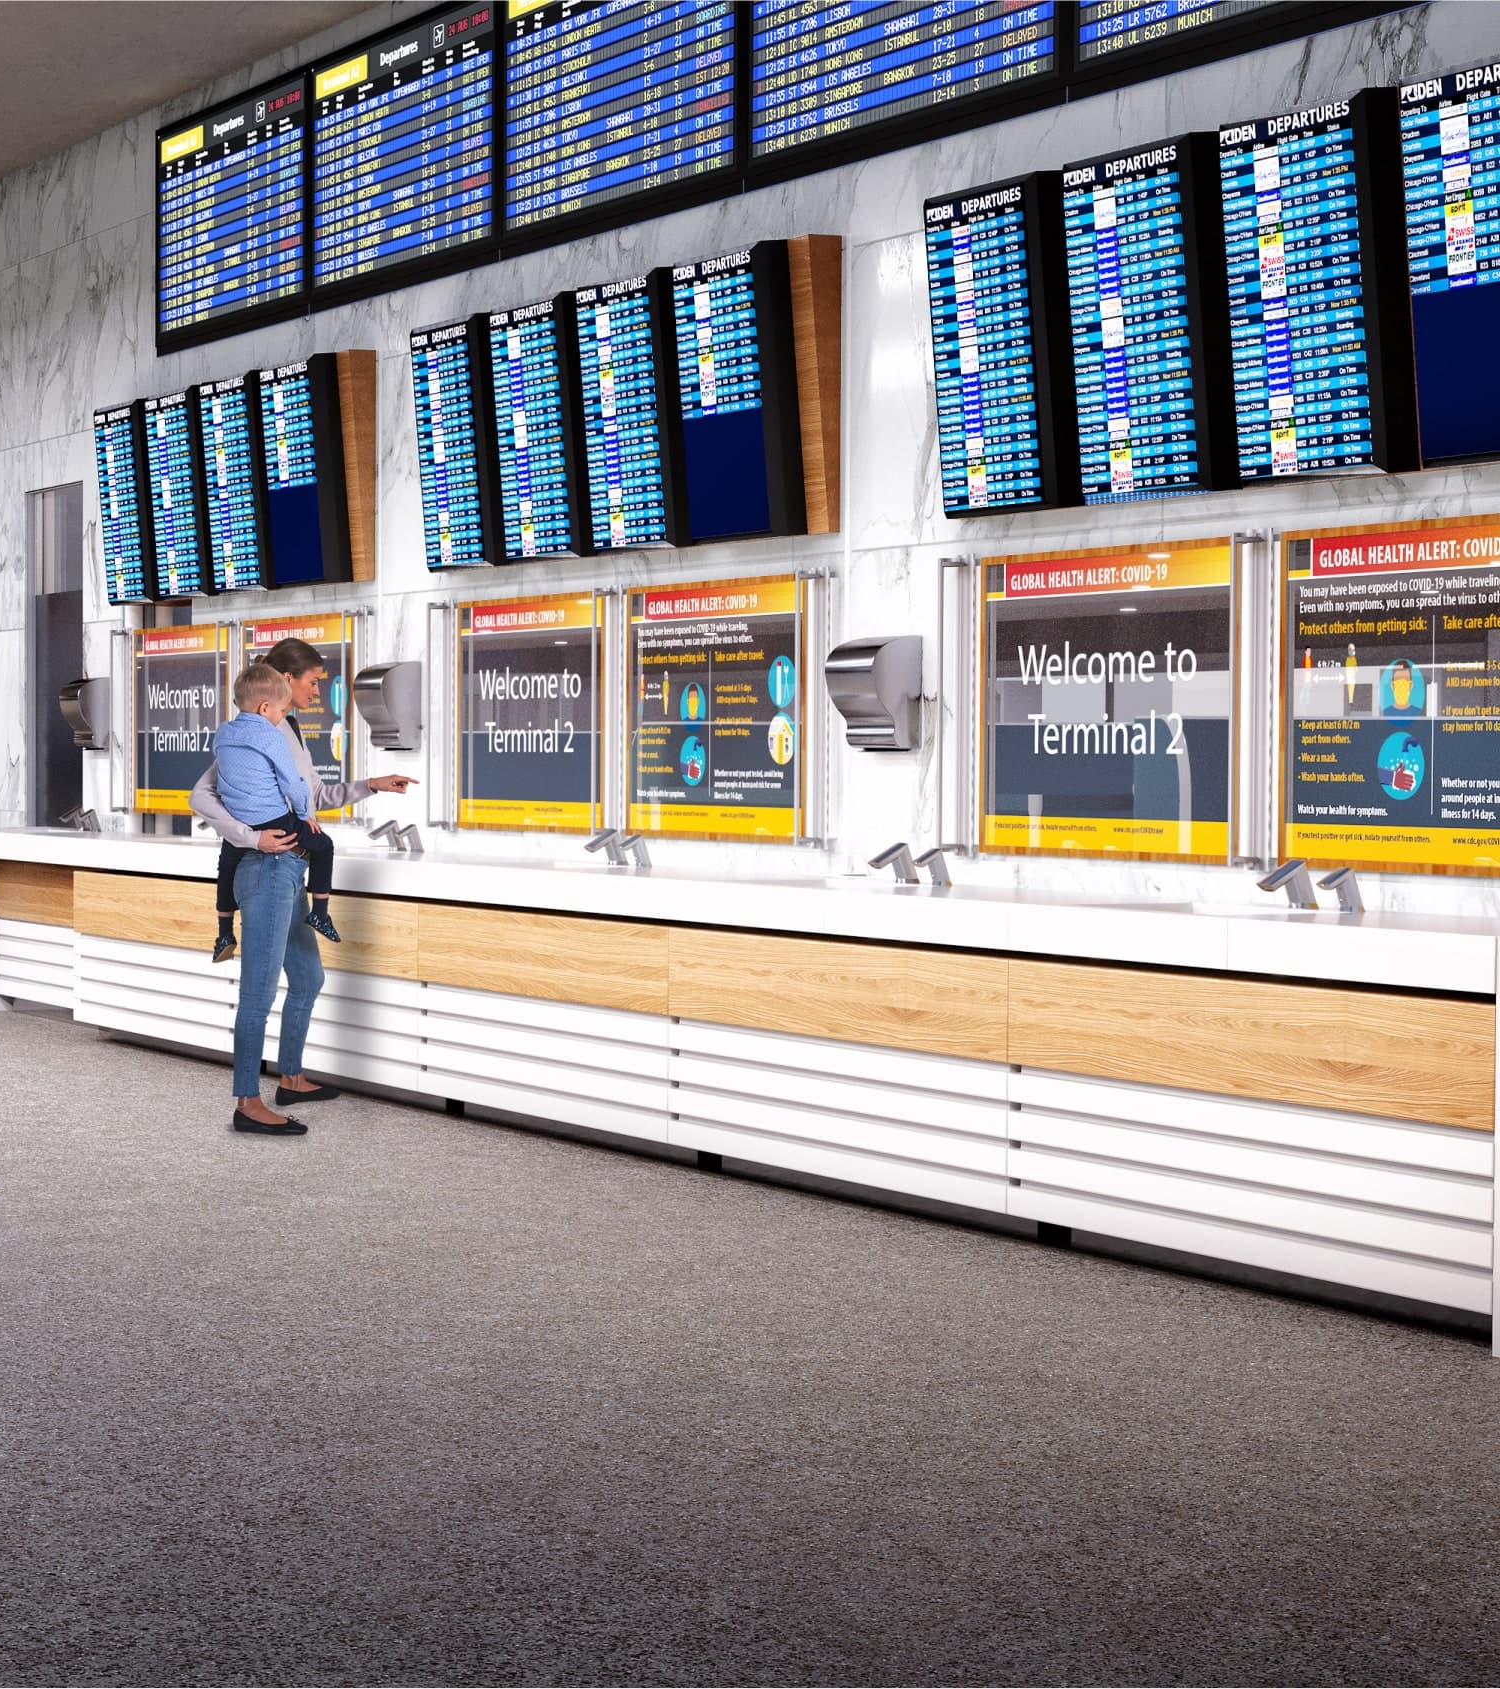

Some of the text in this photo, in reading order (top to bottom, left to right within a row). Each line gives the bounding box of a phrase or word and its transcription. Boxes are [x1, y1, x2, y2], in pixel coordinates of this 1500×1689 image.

[1098, 3, 1167, 36] 13:25 LR 5762
[1144, 22, 1167, 40] 6239
[1178, 8, 1213, 31] MUNICH
[846, 48, 863, 64] KONG
[884, 30, 920, 52] ISTANBUL
[975, 8, 984, 22] 18
[380, 40, 418, 66] Departures
[766, 8, 1038, 107] 12:55 ST 9544 LOS ANGELES 17-21 4 ON TIME
[824, 81, 863, 104] SINGAPORE
[884, 64, 916, 85] BANGKOK
[932, 51, 956, 70] 23-25
[974, 42, 984, 57] 27
[1002, 26, 1038, 48] DELAYED
[765, 121, 785, 138] 13:25
[788, 118, 797, 131] LR
[800, 112, 817, 127] 5762
[824, 98, 858, 119] BRUSSELS
[975, 60, 984, 74] 19
[1002, 50, 1013, 65] ON
[1018, 43, 1038, 61] TIME
[765, 137, 785, 153] 13:40
[800, 128, 816, 142] 6239
[824, 117, 850, 135] MUNICH
[933, 84, 956, 103] 12-14
[974, 78, 979, 91] 3
[1002, 68, 1013, 82] ON
[1018, 61, 1037, 78] TIME
[1268, 100, 1350, 136] DEPARTURES
[213, 116, 244, 137] Departures
[1105, 145, 1176, 178] DEPARTURES
[962, 186, 1021, 215] DEPARTURES
[702, 250, 751, 275] DEPARTURES
[602, 275, 646, 298] DEPARTURES
[513, 300, 553, 322] DEPARTURES
[432, 324, 466, 343] DEPARTURES
[278, 361, 308, 379] DEPARTURES
[1320, 547, 1364, 568] GLOBAL
[1368, 543, 1414, 564] HEALTH
[1417, 540, 1460, 561] ALERT:
[1010, 563, 1168, 590] GLOBAL HEALTH ALERT: COVID-19
[1300, 586, 1312, 598] You
[1314, 587, 1328, 598] may
[1330, 584, 1347, 596] have
[1348, 582, 1366, 595] been
[1368, 580, 1398, 596] exposed
[1400, 581, 1407, 592] to
[1409, 577, 1444, 591] COVID-19
[1445, 576, 1467, 589] while
[648, 594, 758, 615] GLOBAL HEALTH ALERT: COVID-19
[1300, 602, 1316, 614] Even
[1317, 601, 1333, 613] with
[1335, 603, 1345, 612] no
[1346, 599, 1385, 613] symptoms,
[1386, 600, 1400, 611] you
[1401, 598, 1414, 608] can
[1416, 594, 1441, 610] spread
[1443, 593, 1457, 605] the
[1458, 593, 1476, 605] virus
[1478, 593, 1487, 604] to
[475, 609, 565, 628] GLOBAL HEALTH ALERT: COVID-19
[1300, 616, 1427, 636] Protect others from getting sick:
[1443, 616, 1482, 630] Take care
[1018, 640, 1197, 685] Welcome to
[148, 681, 214, 710] Welcome to
[479, 666, 581, 700] Welcome to
[152, 724, 210, 752] Terminal 2
[485, 719, 574, 753] Terminal 2
[1028, 709, 1184, 754] Terminal 2
[1441, 777, 1468, 788] Whether
[1469, 780, 1476, 788] or
[1476, 778, 1487, 788] not
[1298, 804, 1388, 818] Watch your health for symptoms.
[1441, 793, 1493, 806] around people at
[1441, 808, 1496, 822] illness for 14 days.
